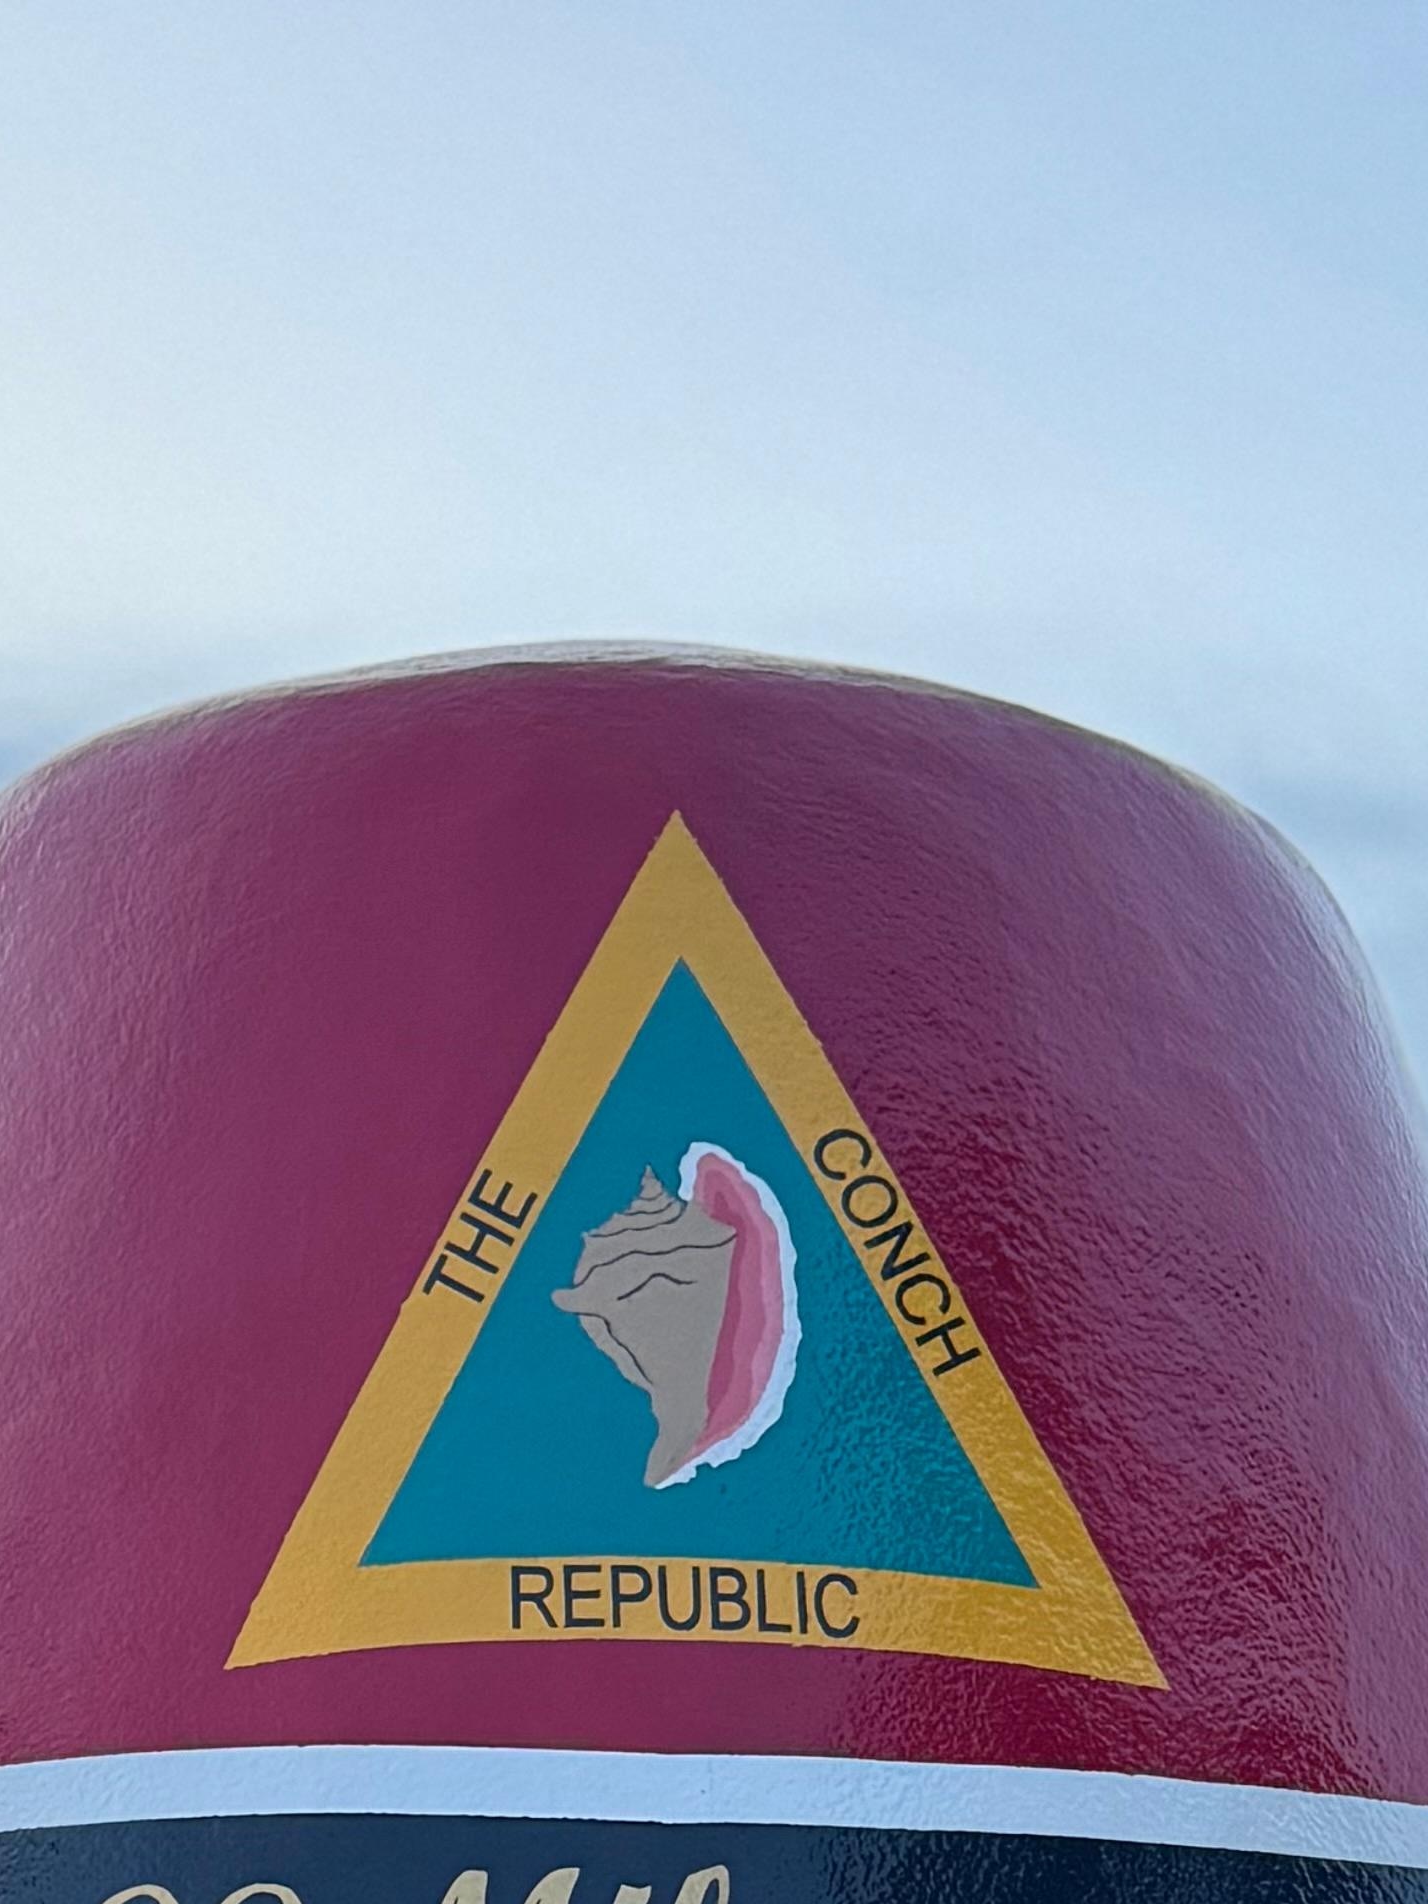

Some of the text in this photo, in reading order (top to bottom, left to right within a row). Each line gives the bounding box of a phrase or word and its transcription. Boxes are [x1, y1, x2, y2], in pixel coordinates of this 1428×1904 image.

[423, 1168, 538, 1309] THE
[813, 1128, 982, 1377] CONCH
[509, 1564, 860, 1640] REPUBLIC
